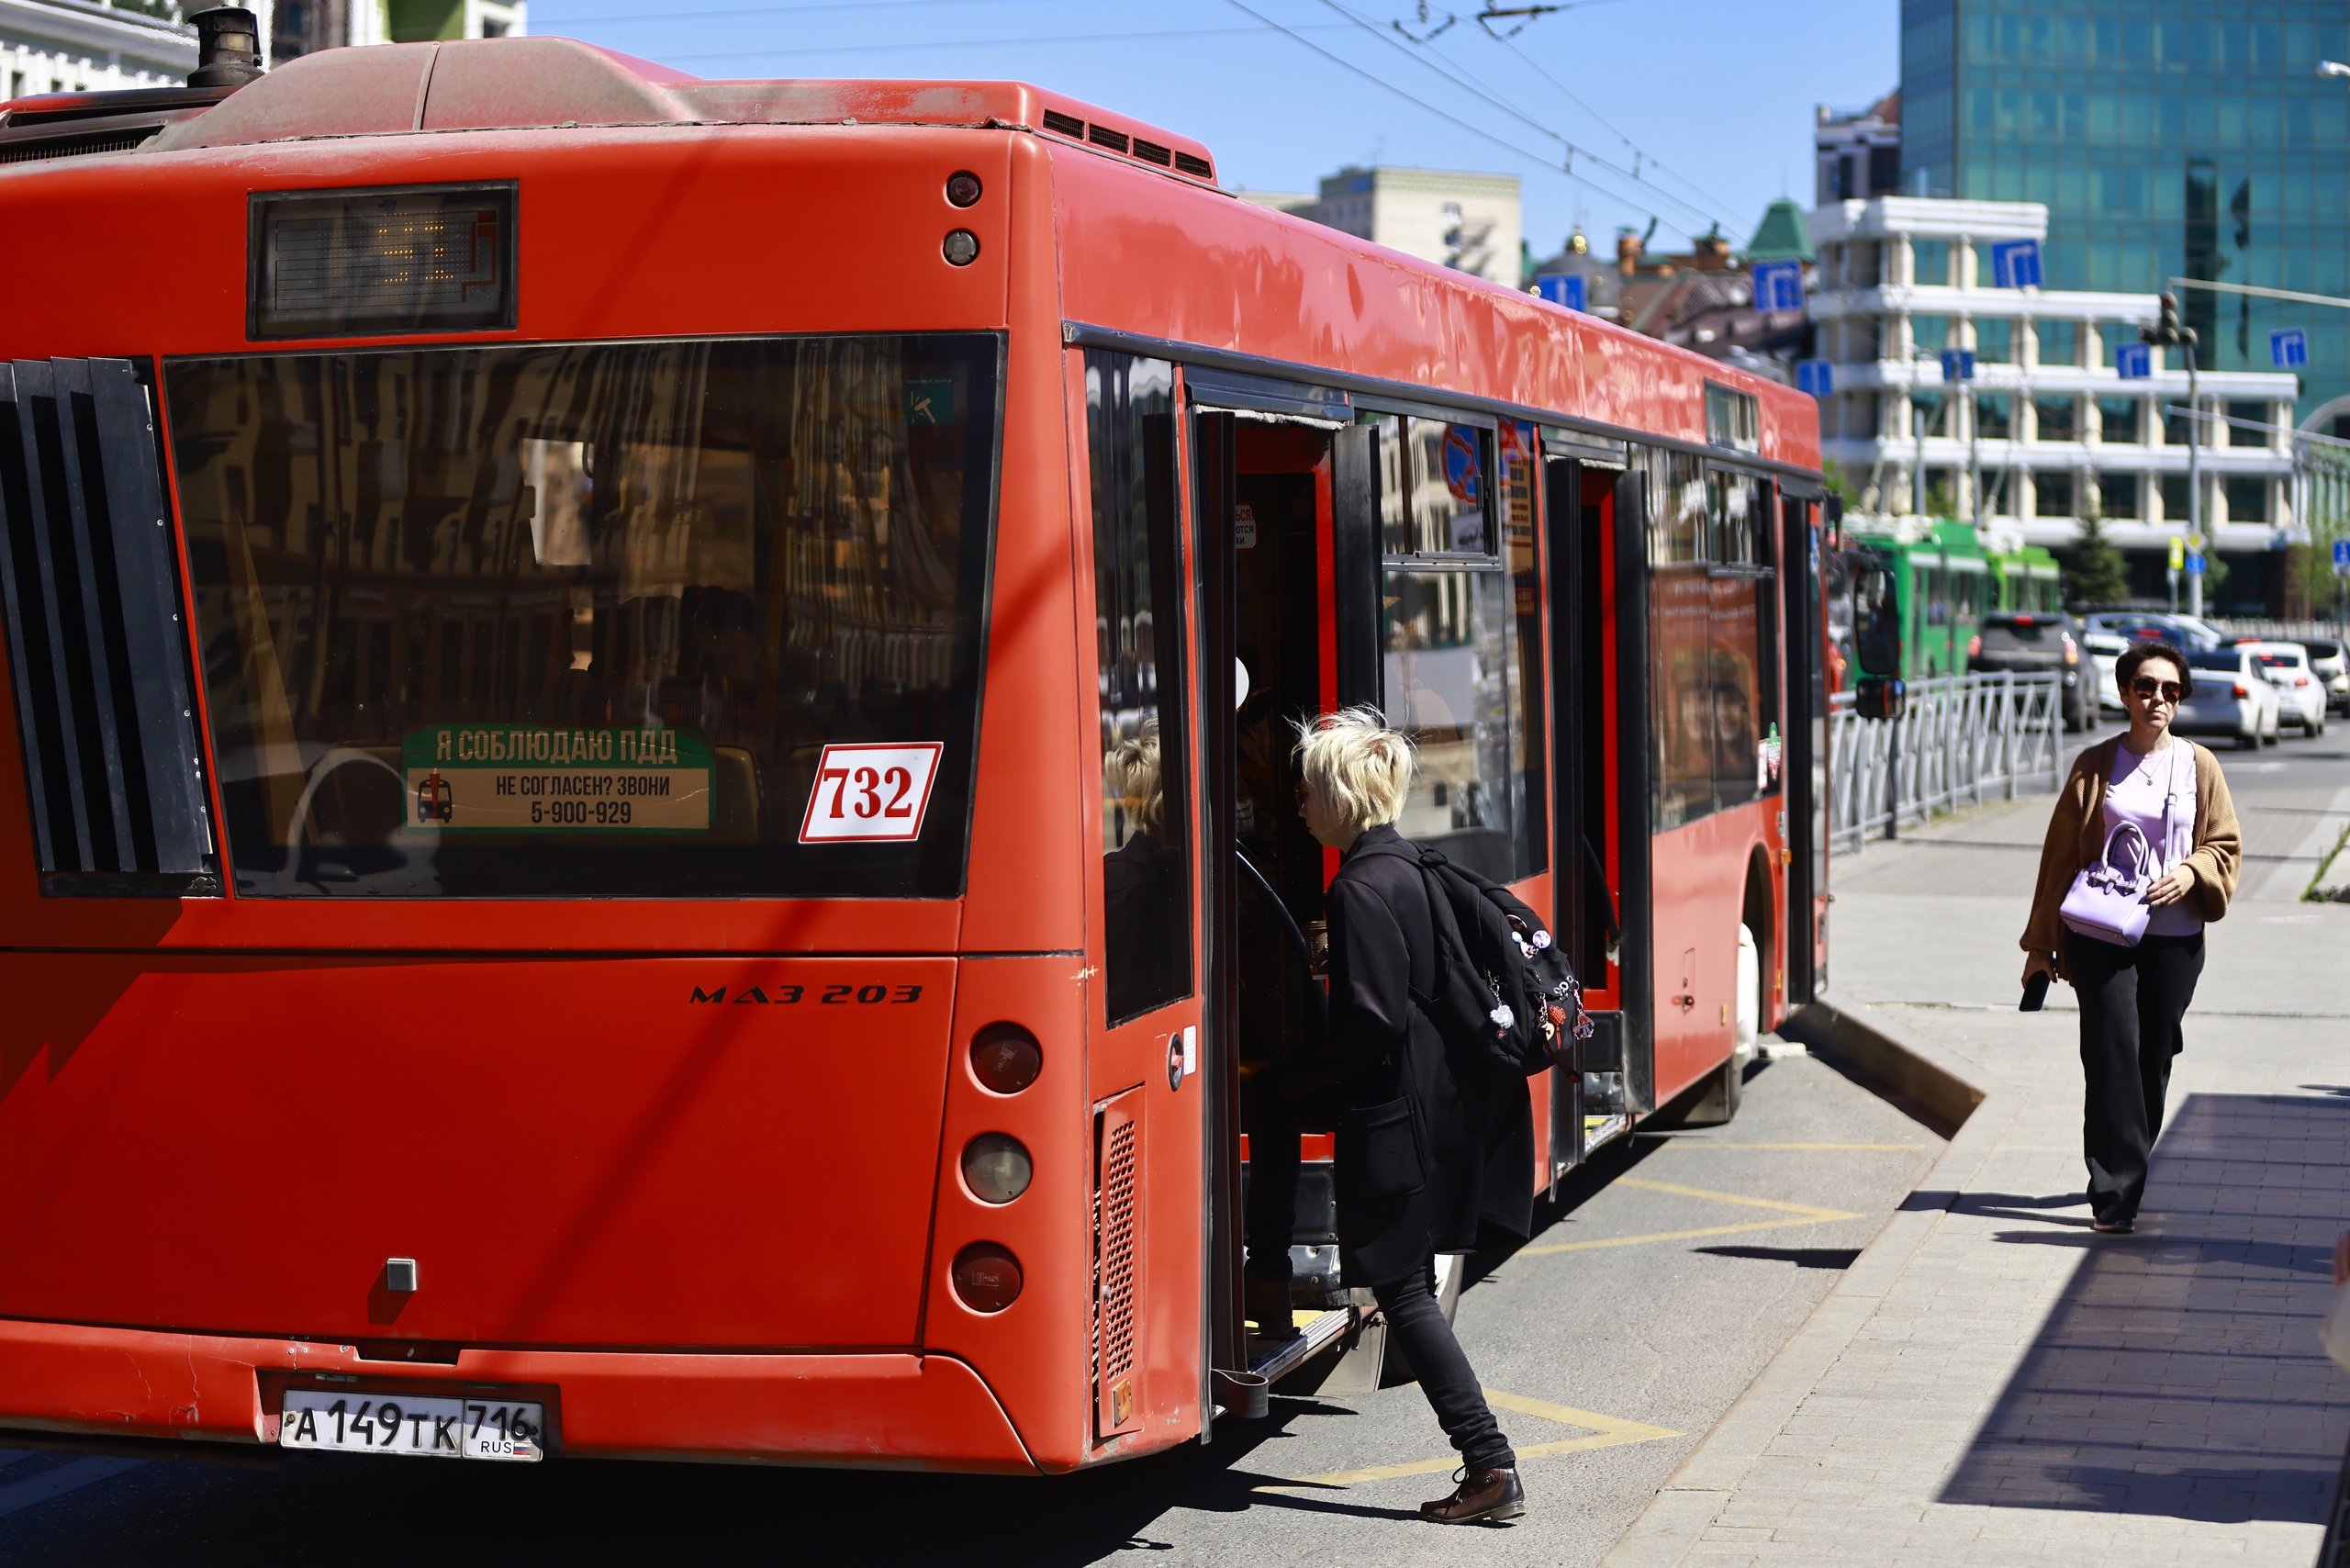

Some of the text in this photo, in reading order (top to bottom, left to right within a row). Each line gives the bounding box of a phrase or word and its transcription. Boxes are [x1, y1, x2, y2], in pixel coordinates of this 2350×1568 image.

[436, 730, 678, 765] Я СОБЛЮДАЮ ПДД
[496, 776, 670, 796] НЕ СОГЛАСЕН? ЗВОНИ
[823, 766, 912, 819] 732
[531, 801, 632, 824] 5-900-929
[689, 984, 923, 1004] МАЗ 203
[468, 1405, 531, 1441] 716
[480, 1440, 513, 1454] RUS
